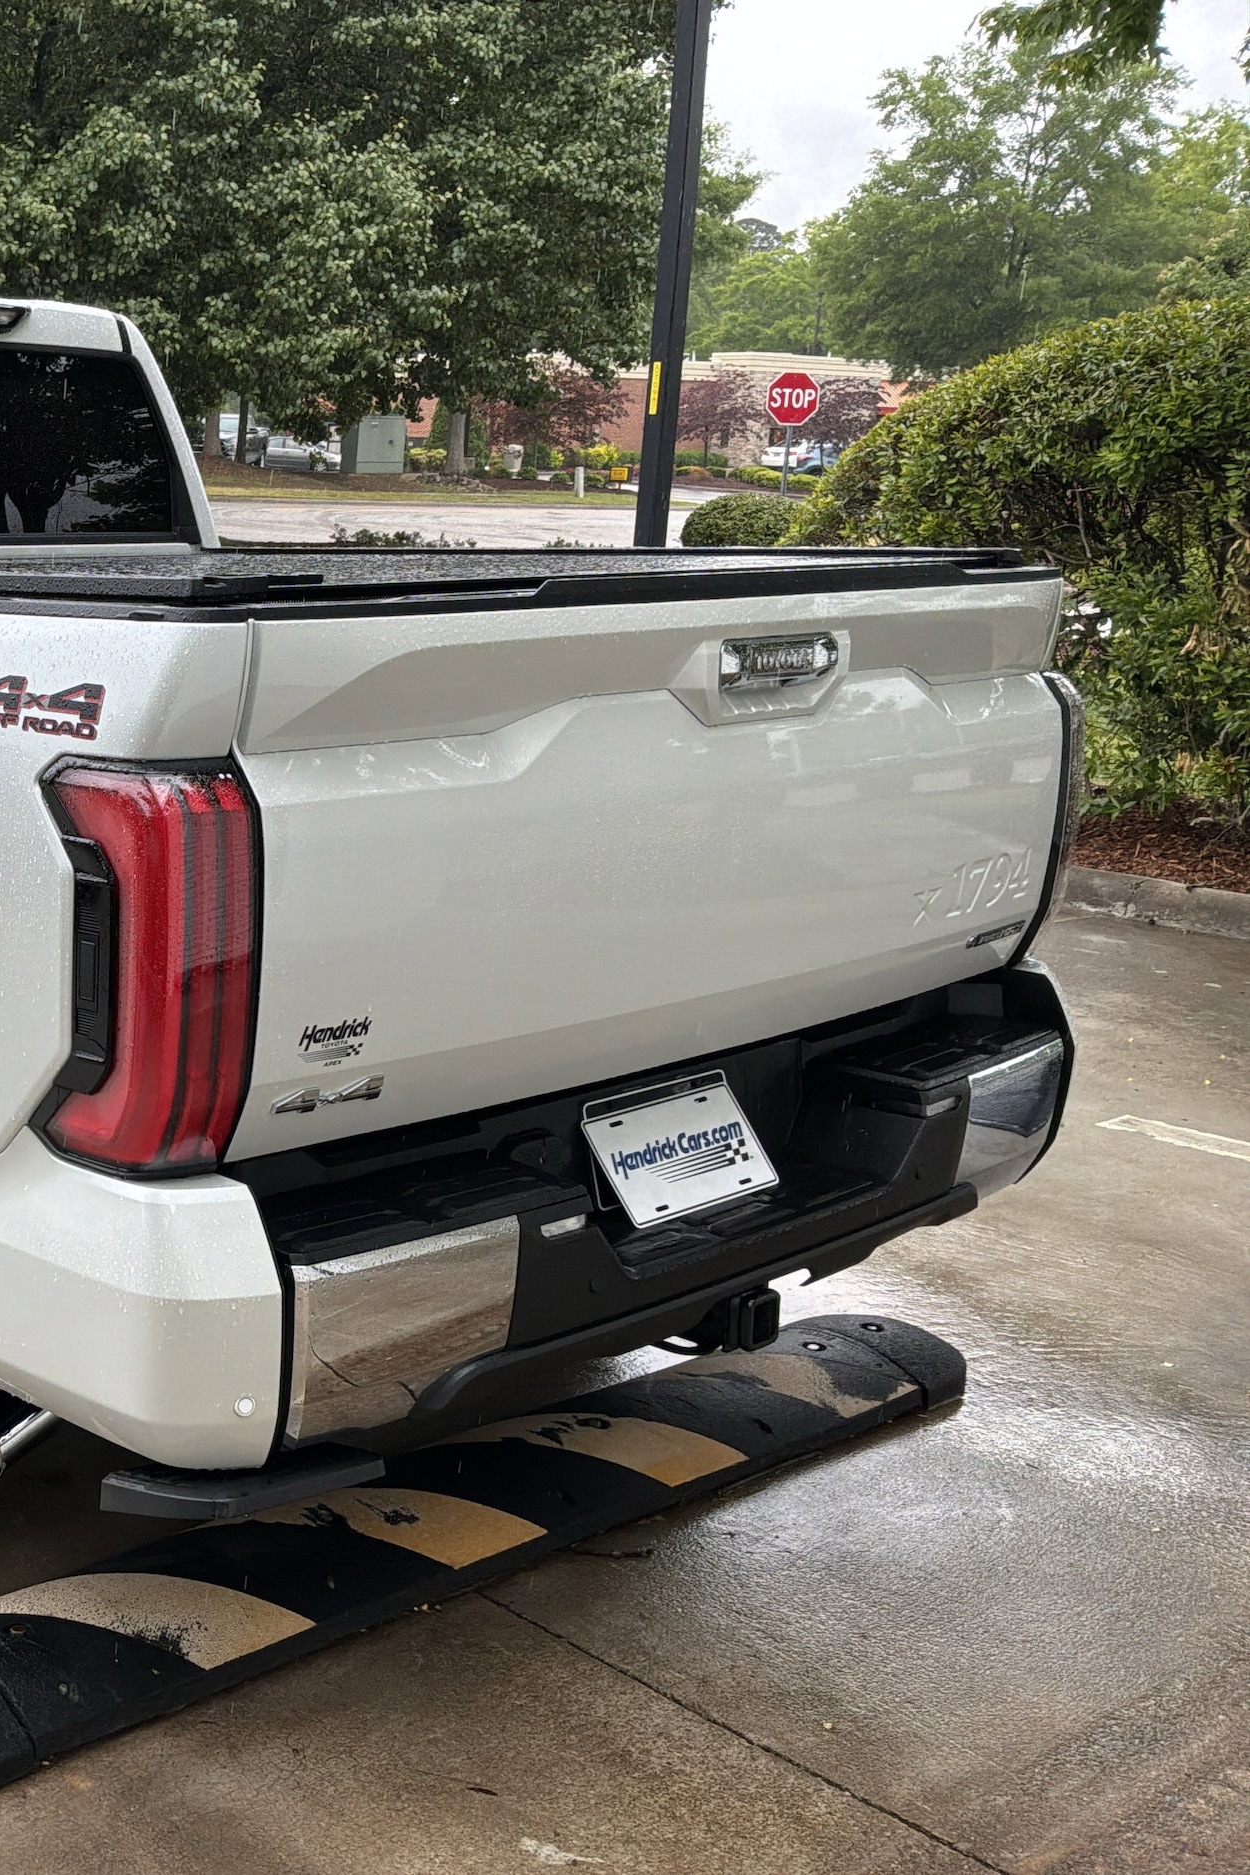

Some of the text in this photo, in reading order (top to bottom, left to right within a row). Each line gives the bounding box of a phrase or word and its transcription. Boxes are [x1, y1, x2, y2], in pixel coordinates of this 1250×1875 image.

[770, 388, 816, 409] STOP
[22, 715, 97, 741] ROAD
[946, 848, 1032, 918] 1794
[298, 1016, 372, 1052] Hendrick
[321, 1040, 348, 1049] TOYOTA
